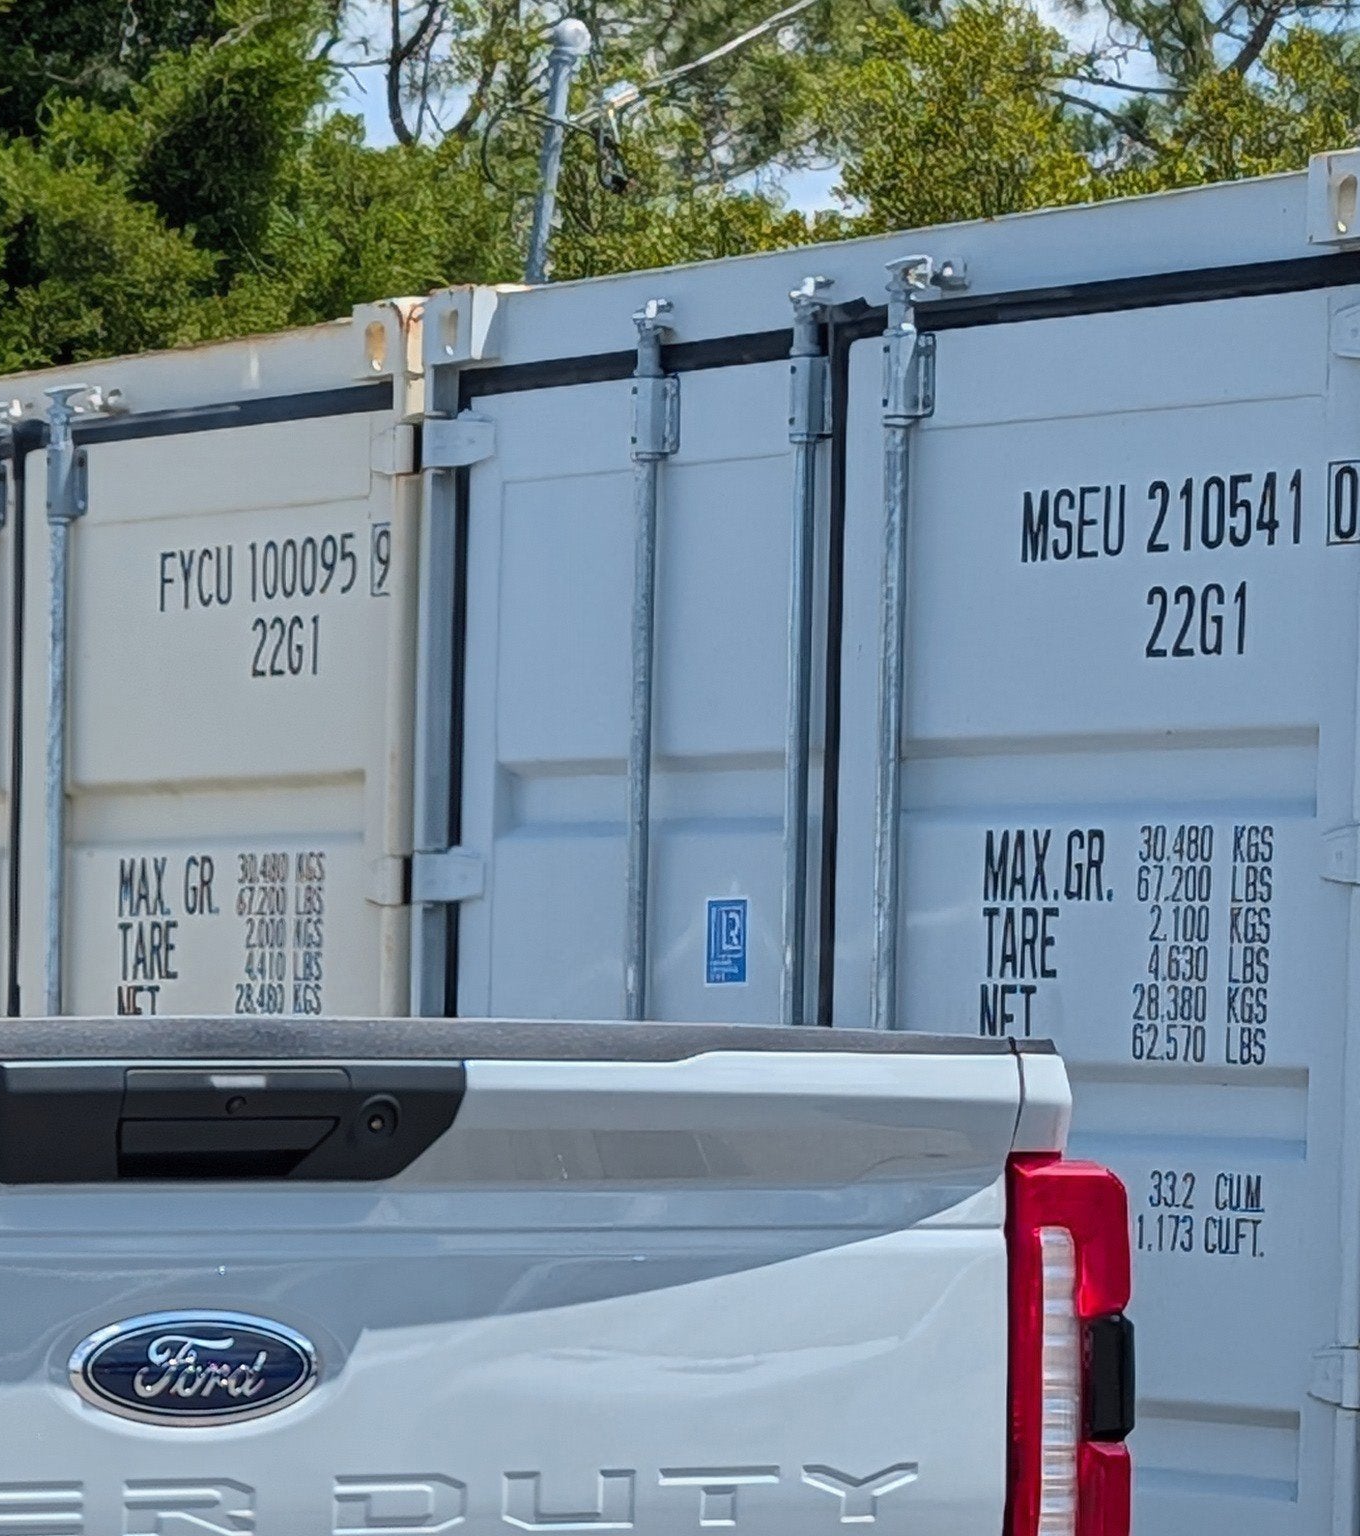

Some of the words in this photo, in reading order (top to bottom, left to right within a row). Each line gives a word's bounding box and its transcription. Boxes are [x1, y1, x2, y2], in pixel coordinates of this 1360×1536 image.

[1021, 484, 1127, 563] MSEU
[1146, 468, 1304, 553] 210541
[1334, 465, 1359, 539] 0
[159, 544, 233, 612] FYCU
[248, 532, 357, 600] 100095
[1145, 579, 1247, 659] 22G1
[250, 614, 320, 678] 22G1
[1138, 824, 1214, 863] 30.480
[1232, 824, 1274, 863] KGS
[294, 884, 325, 916] LBS
[1136, 864, 1212, 902] 67.200
[1230, 864, 1273, 903] LBS
[117, 919, 179, 982] TARE
[292, 950, 324, 982] LBS
[982, 906, 1060, 979] TARE
[1148, 904, 1210, 943] 2.100
[1229, 905, 1271, 945] KGS
[1147, 944, 1208, 982] 4.630
[1228, 945, 1270, 984] LBS
[1132, 982, 1207, 1023] 28.380
[1226, 985, 1268, 1024] KGS
[1131, 1023, 1207, 1063] 62.570
[1225, 1026, 1268, 1065] LBS
[1137, 1213, 1195, 1252] 1.173
[133, 1333, 268, 1399] Ford
[332, 1461, 920, 1536] DUTY
